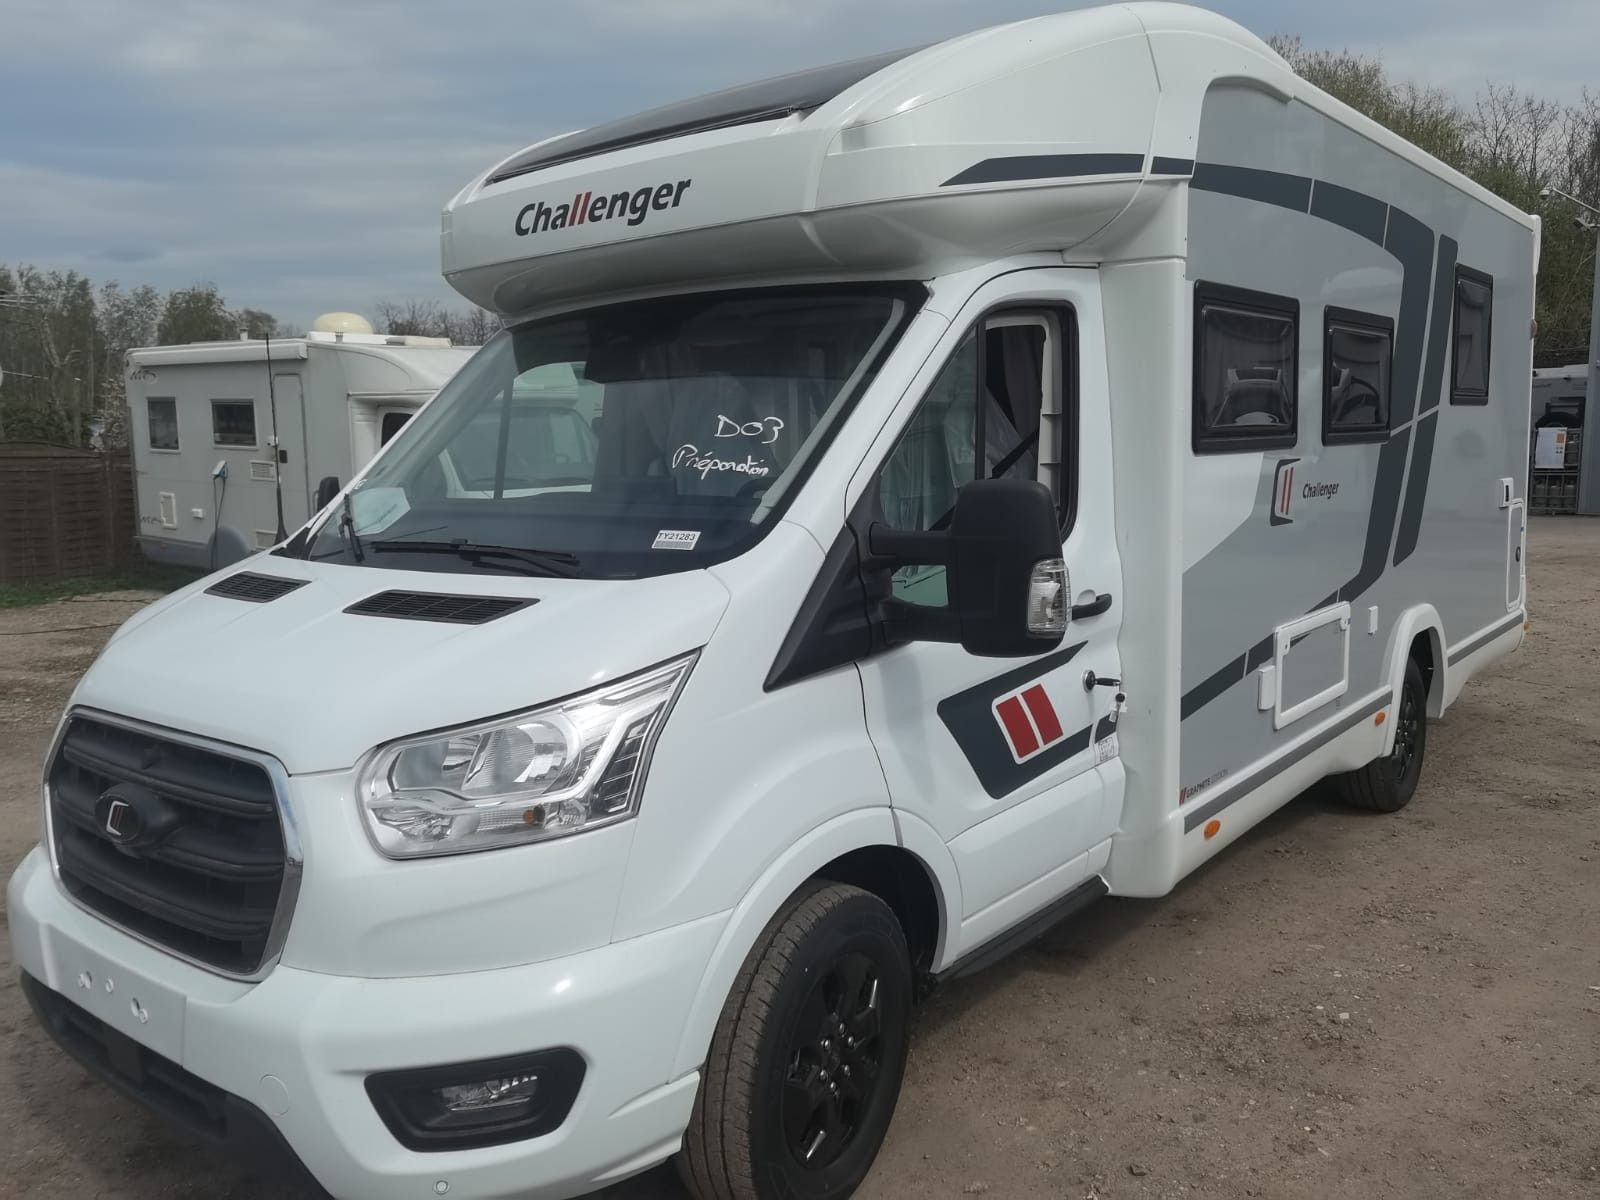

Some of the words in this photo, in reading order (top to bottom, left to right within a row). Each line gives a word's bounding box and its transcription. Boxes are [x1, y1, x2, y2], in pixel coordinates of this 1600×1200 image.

[514, 178, 692, 237] Challenger
[1302, 482, 1340, 500] Challenger
[658, 532, 696, 541] TY21283
